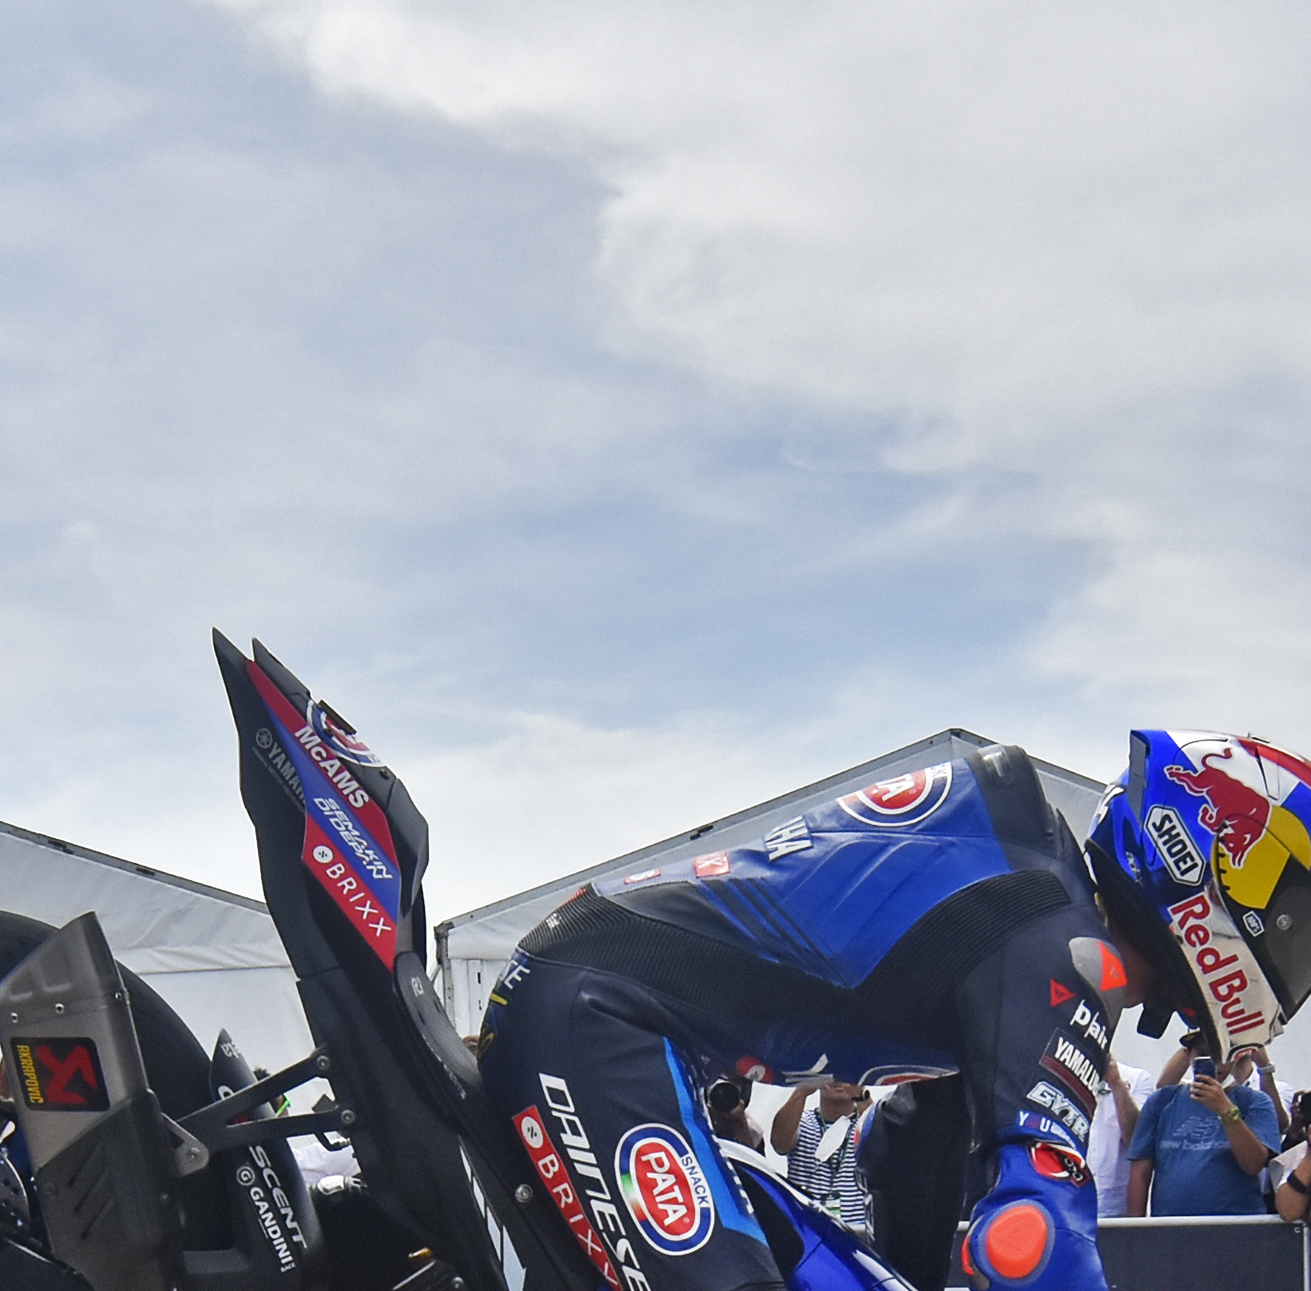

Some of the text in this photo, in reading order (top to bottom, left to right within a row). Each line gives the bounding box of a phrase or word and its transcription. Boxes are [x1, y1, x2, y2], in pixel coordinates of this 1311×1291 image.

[268, 742, 306, 804] YAMAH
[294, 725, 369, 809] McAMS
[326, 797, 392, 879] SEMAKIN
[329, 817, 383, 879] DEPAN
[1152, 813, 1199, 877] SHOEI
[326, 863, 391, 937] BRIXX
[1167, 894, 1265, 1036] Red Bull
[1026, 1081, 1091, 1143] GYTR
[641, 1151, 682, 1227] PATA
[681, 1155, 711, 1208] SNACK
[249, 1187, 293, 1265] GANDINI
